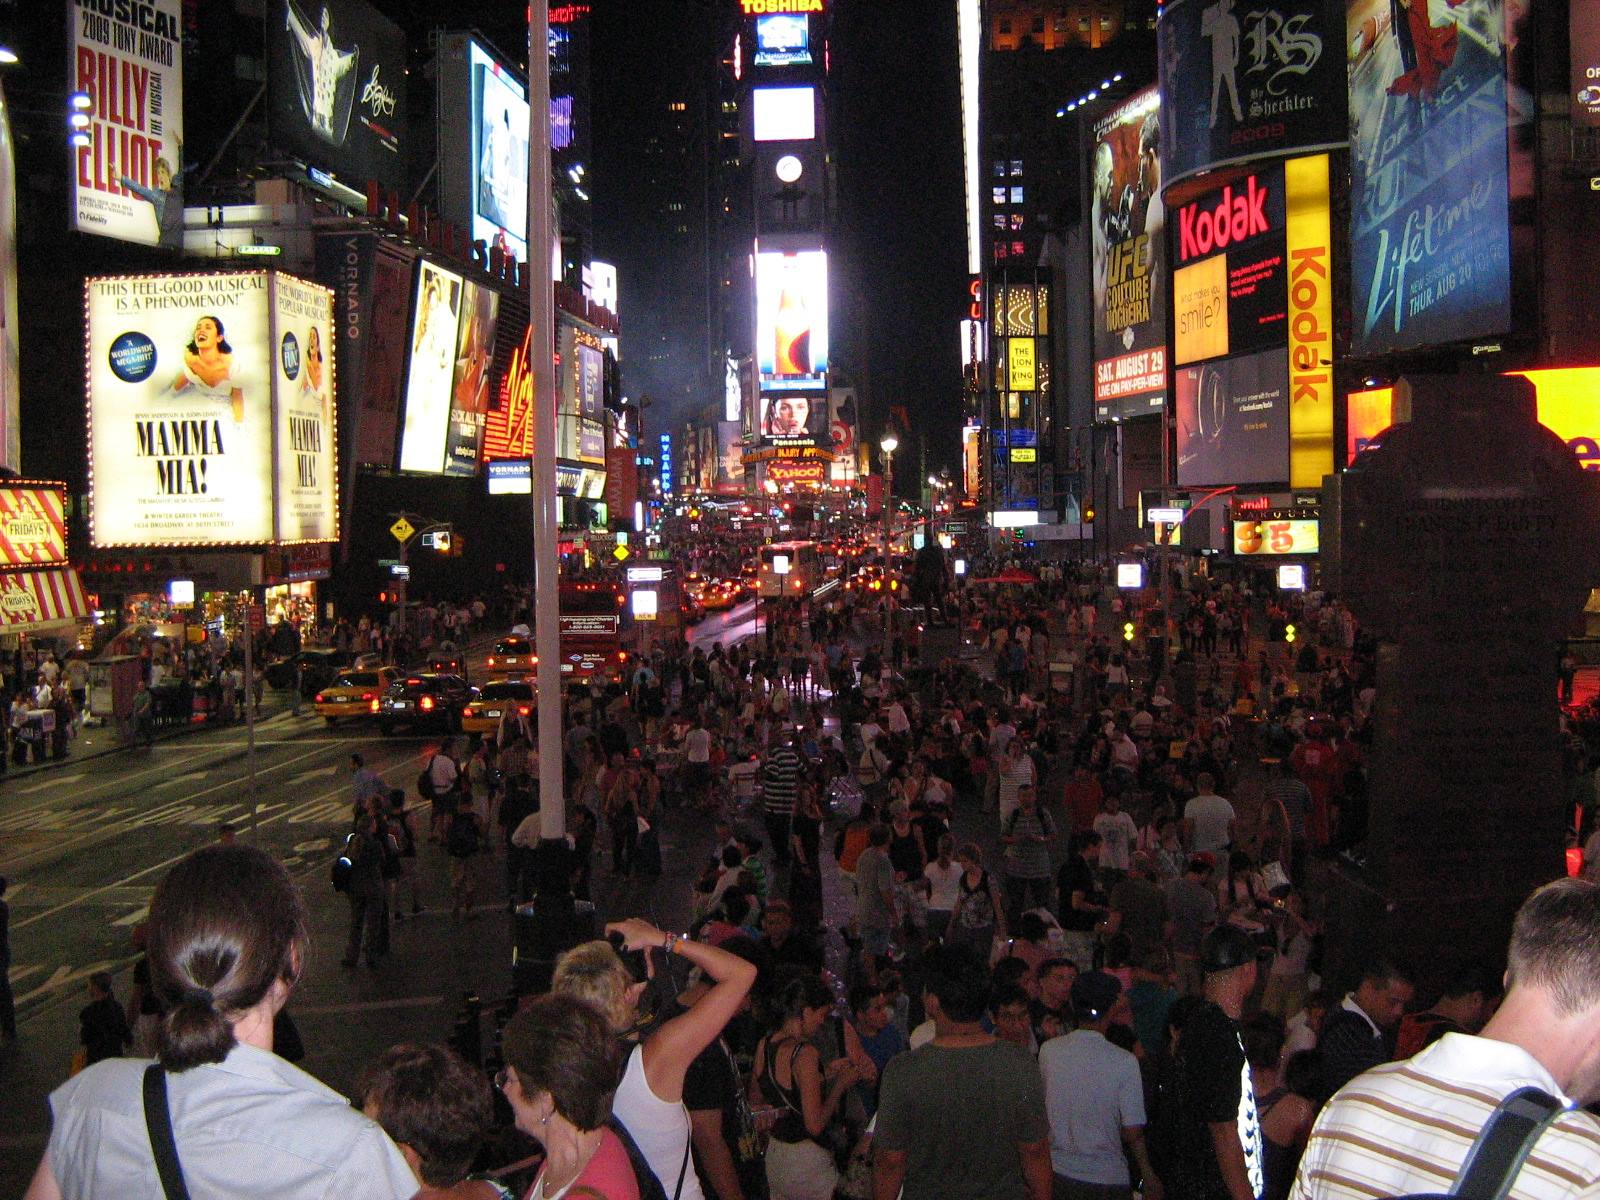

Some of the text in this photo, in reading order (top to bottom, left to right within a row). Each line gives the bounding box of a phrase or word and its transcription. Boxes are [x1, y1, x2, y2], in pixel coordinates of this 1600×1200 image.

[741, 0, 823, 13] TOSHIBA
[82, 10, 173, 67] 2009 TONY AWARD
[77, 45, 149, 132] BILLY
[150, 71, 163, 136] THE MUSICAL
[1249, 94, 1314, 118] Sheckler
[78, 121, 163, 202] ELLIOT
[85, 213, 108, 225] Fidelity
[1179, 175, 1270, 262] Kodak
[1106, 233, 1150, 288] UFC
[1362, 172, 1493, 338] Lifetime
[93, 276, 266, 297] "THIS FEEL-GOOD MUSICAL
[116, 292, 246, 311] IS A PHENOMENON!"
[346, 238, 360, 340] VORNADO
[1105, 274, 1150, 312] COUTURE
[1409, 290, 1435, 318] THUR.
[1436, 271, 1456, 301] AUG
[1458, 261, 1473, 286] 20
[1105, 297, 1150, 333] NOGUEIRA
[1179, 297, 1221, 336] smile?
[1290, 247, 1329, 404] Kodak
[110, 343, 154, 360] WORLDWIDE
[1011, 356, 1032, 370] LION
[1014, 347, 1030, 356] THE
[1097, 349, 1164, 384] SAT. AUGUST 29
[1011, 371, 1033, 384] KING
[1097, 372, 1164, 398] LIVE ON PAY-PER-VIEW
[288, 416, 322, 454] MAMMA
[464, 411, 475, 425] ALL
[475, 413, 486, 427] THE
[136, 420, 225, 456] MAMMA
[773, 438, 815, 446] Panasonic
[155, 457, 208, 495] MIA!
[296, 453, 316, 488] MIA!
[770, 466, 821, 480] YAHOO!
[9, 523, 45, 536] FRIDAY'S
